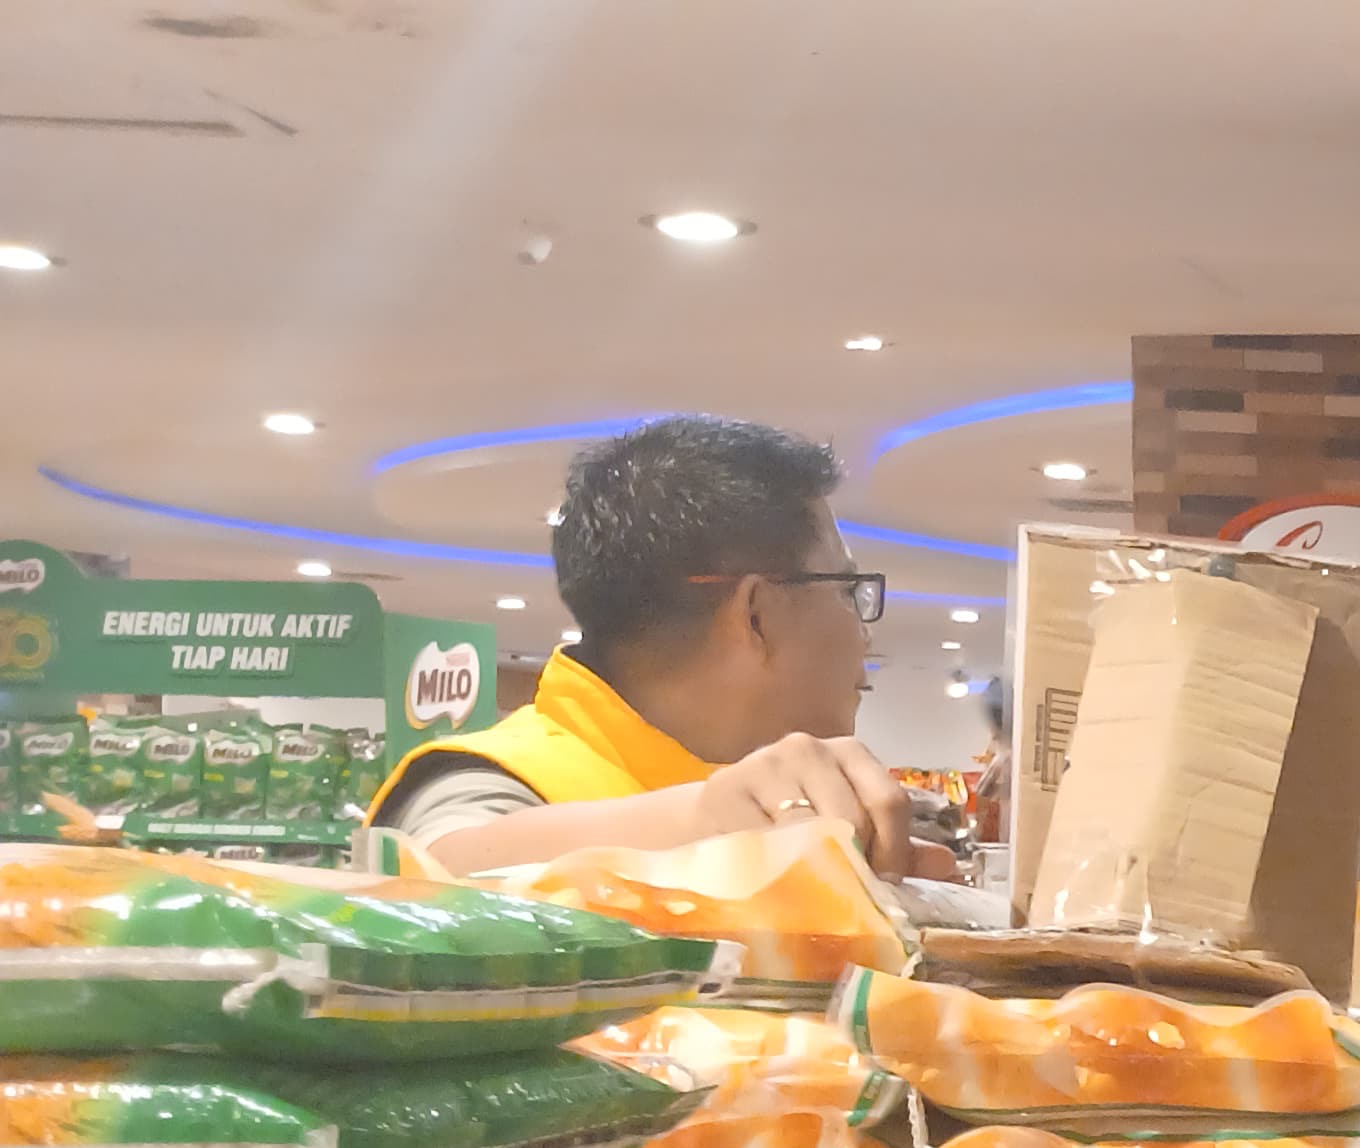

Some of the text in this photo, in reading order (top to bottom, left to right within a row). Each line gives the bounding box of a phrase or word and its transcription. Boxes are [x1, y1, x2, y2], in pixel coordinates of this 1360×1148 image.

[102, 611, 353, 638] ENERGI UNTUK AKTIF
[171, 645, 289, 671] TIAP HARI
[416, 667, 472, 706] MILO
